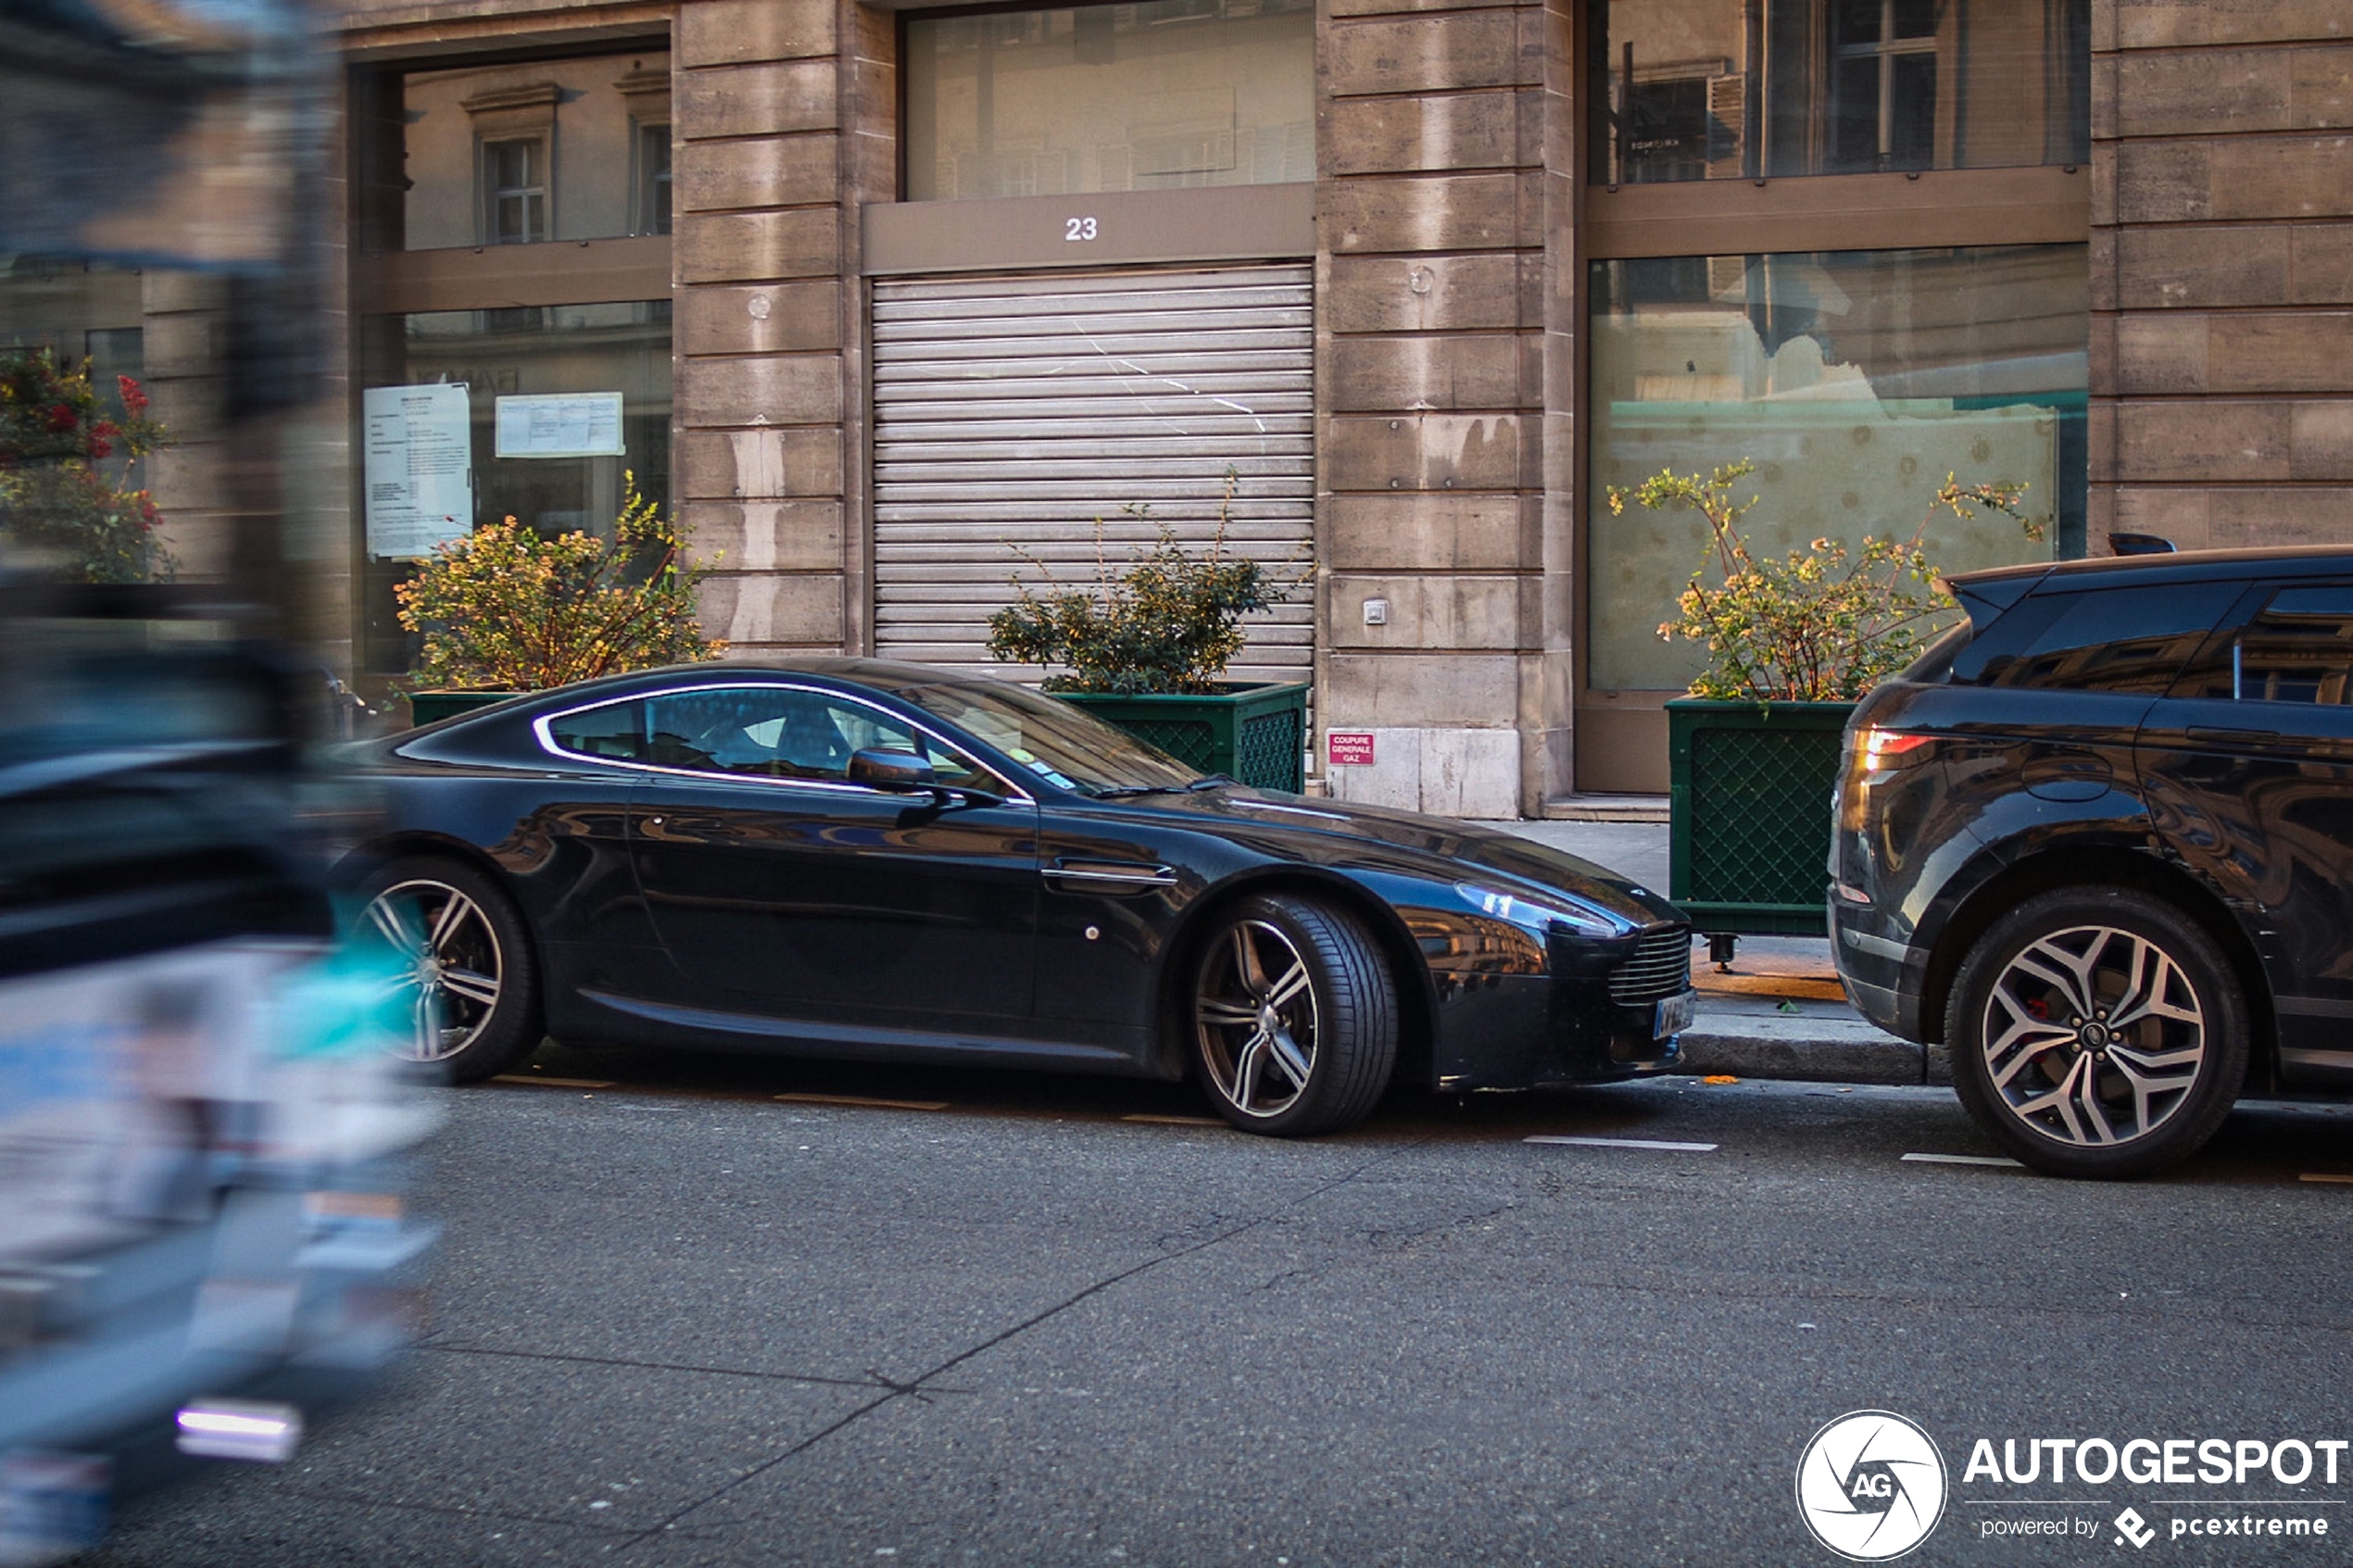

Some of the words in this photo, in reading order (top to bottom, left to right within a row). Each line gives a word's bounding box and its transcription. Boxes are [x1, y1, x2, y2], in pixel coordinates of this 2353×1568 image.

[1065, 217, 1098, 241] 23
[1334, 736, 1369, 745] COUPURE
[1332, 746, 1371, 754] GENERALE
